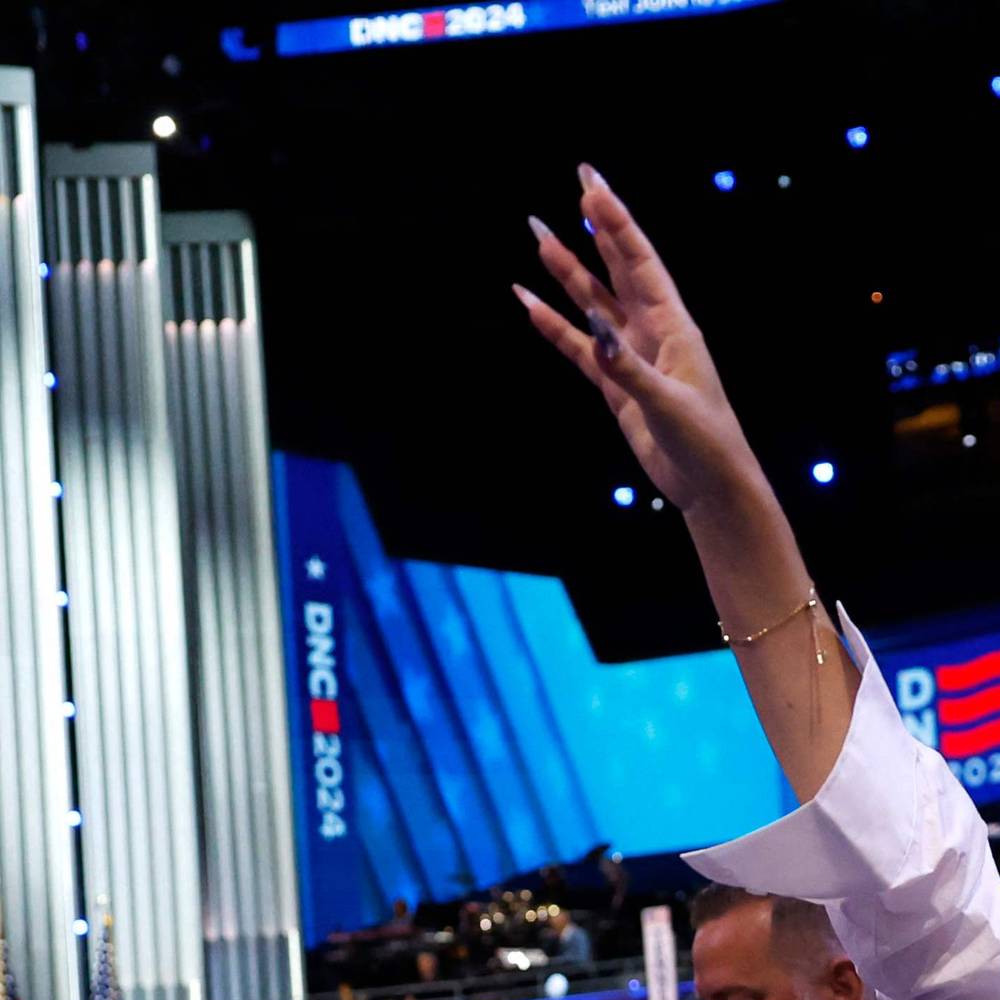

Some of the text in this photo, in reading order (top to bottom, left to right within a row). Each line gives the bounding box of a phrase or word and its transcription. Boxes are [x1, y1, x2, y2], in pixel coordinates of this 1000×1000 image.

[349, 13, 424, 46] DNC
[445, 3, 527, 36] 2024
[304, 602, 346, 841] DNC 2024
